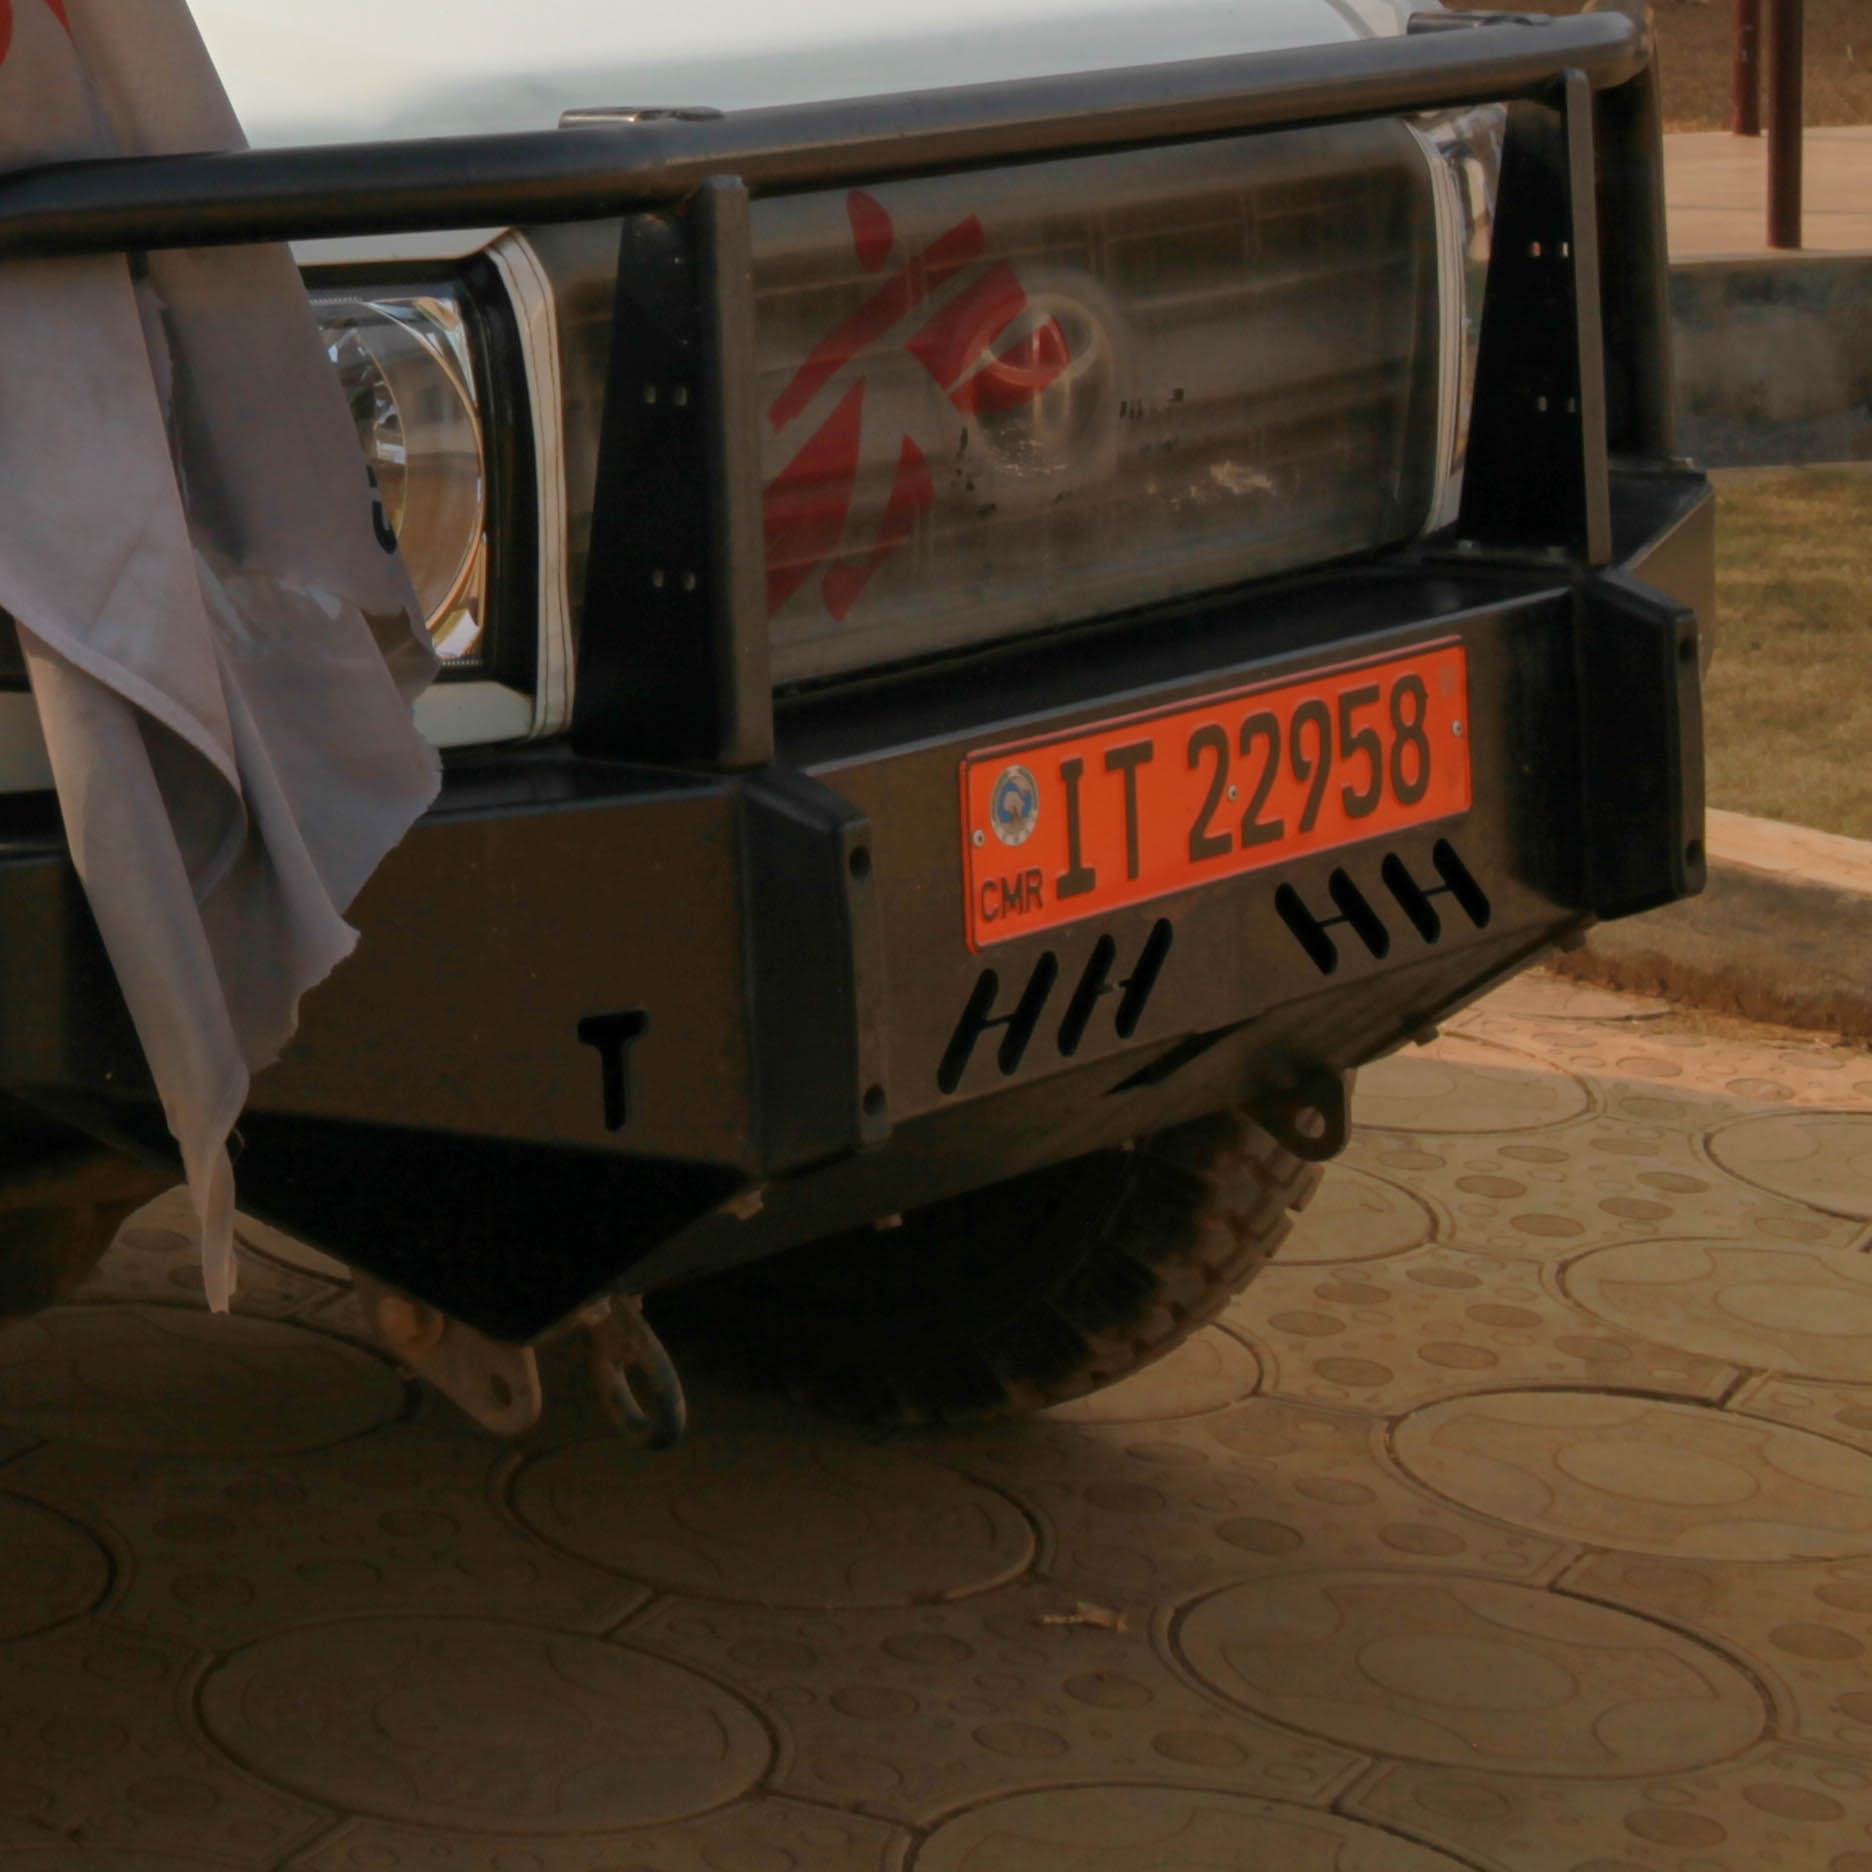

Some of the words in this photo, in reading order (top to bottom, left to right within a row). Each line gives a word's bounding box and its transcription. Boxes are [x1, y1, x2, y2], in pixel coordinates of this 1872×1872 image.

[1056, 738, 1154, 901] IT
[1186, 673, 1431, 865] 22958
[980, 867, 1044, 924] CMR
